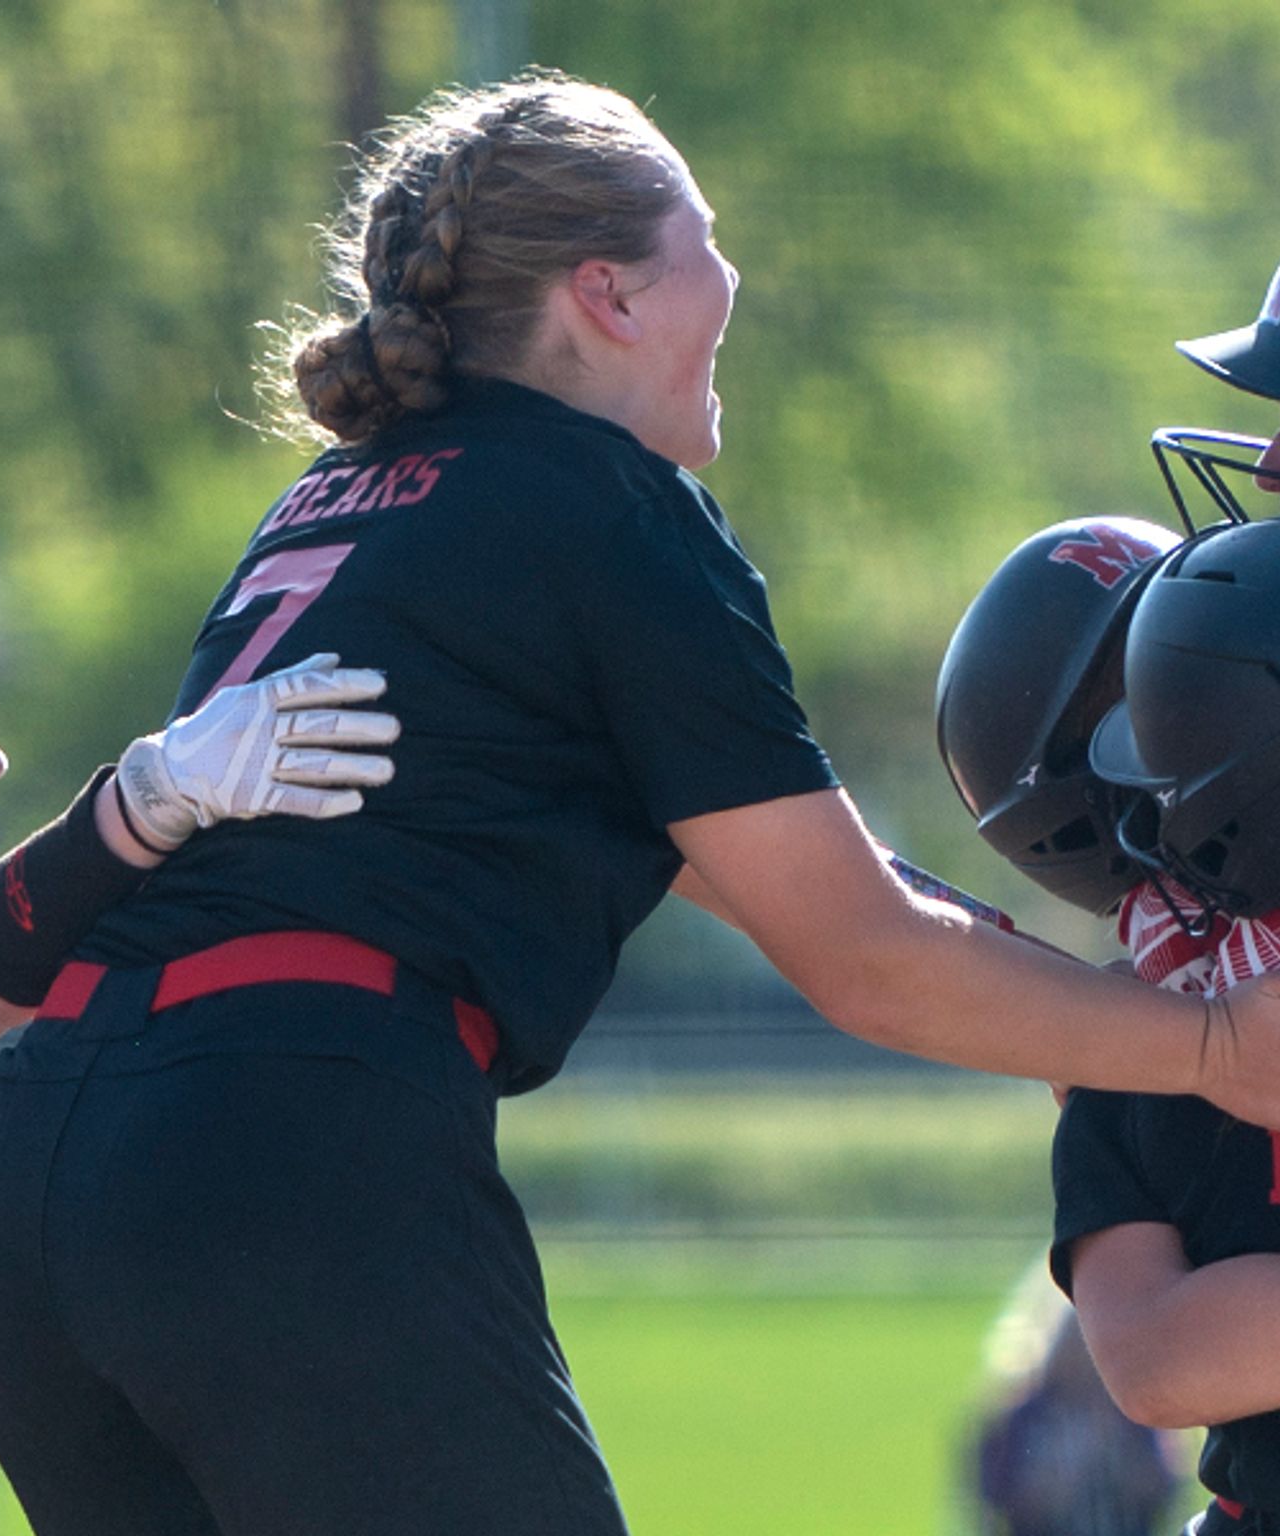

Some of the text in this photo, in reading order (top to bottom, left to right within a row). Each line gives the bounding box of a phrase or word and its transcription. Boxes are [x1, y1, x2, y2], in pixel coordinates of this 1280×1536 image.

[257, 447, 465, 537] BEARS
[1048, 523, 1162, 590] M
[201, 542, 358, 709] 7
[127, 765, 169, 811] NIKE
